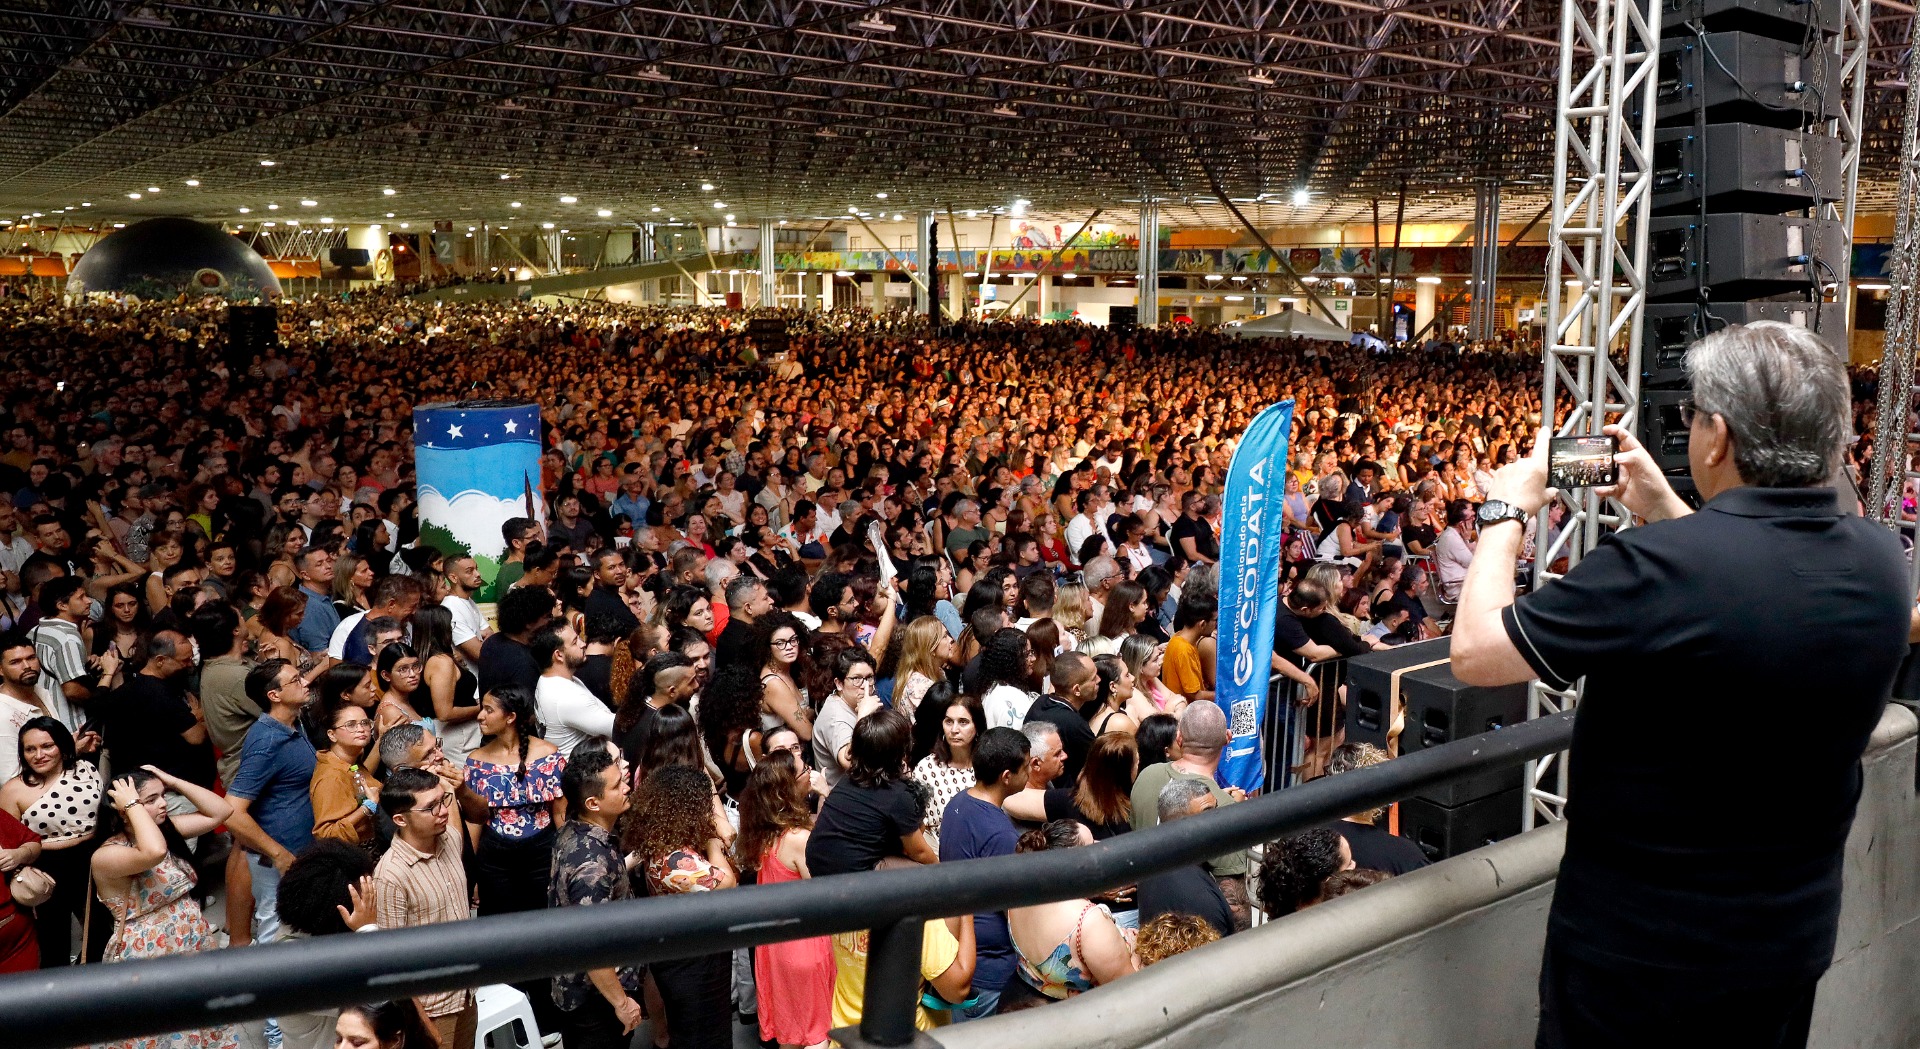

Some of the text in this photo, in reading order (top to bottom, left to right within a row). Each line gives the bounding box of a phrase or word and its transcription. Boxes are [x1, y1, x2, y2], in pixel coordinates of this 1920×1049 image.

[439, 240, 451, 259] 2
[1232, 611, 1241, 654] Evento
[1240, 495, 1248, 522] pela
[1241, 457, 1267, 629] CODATA
